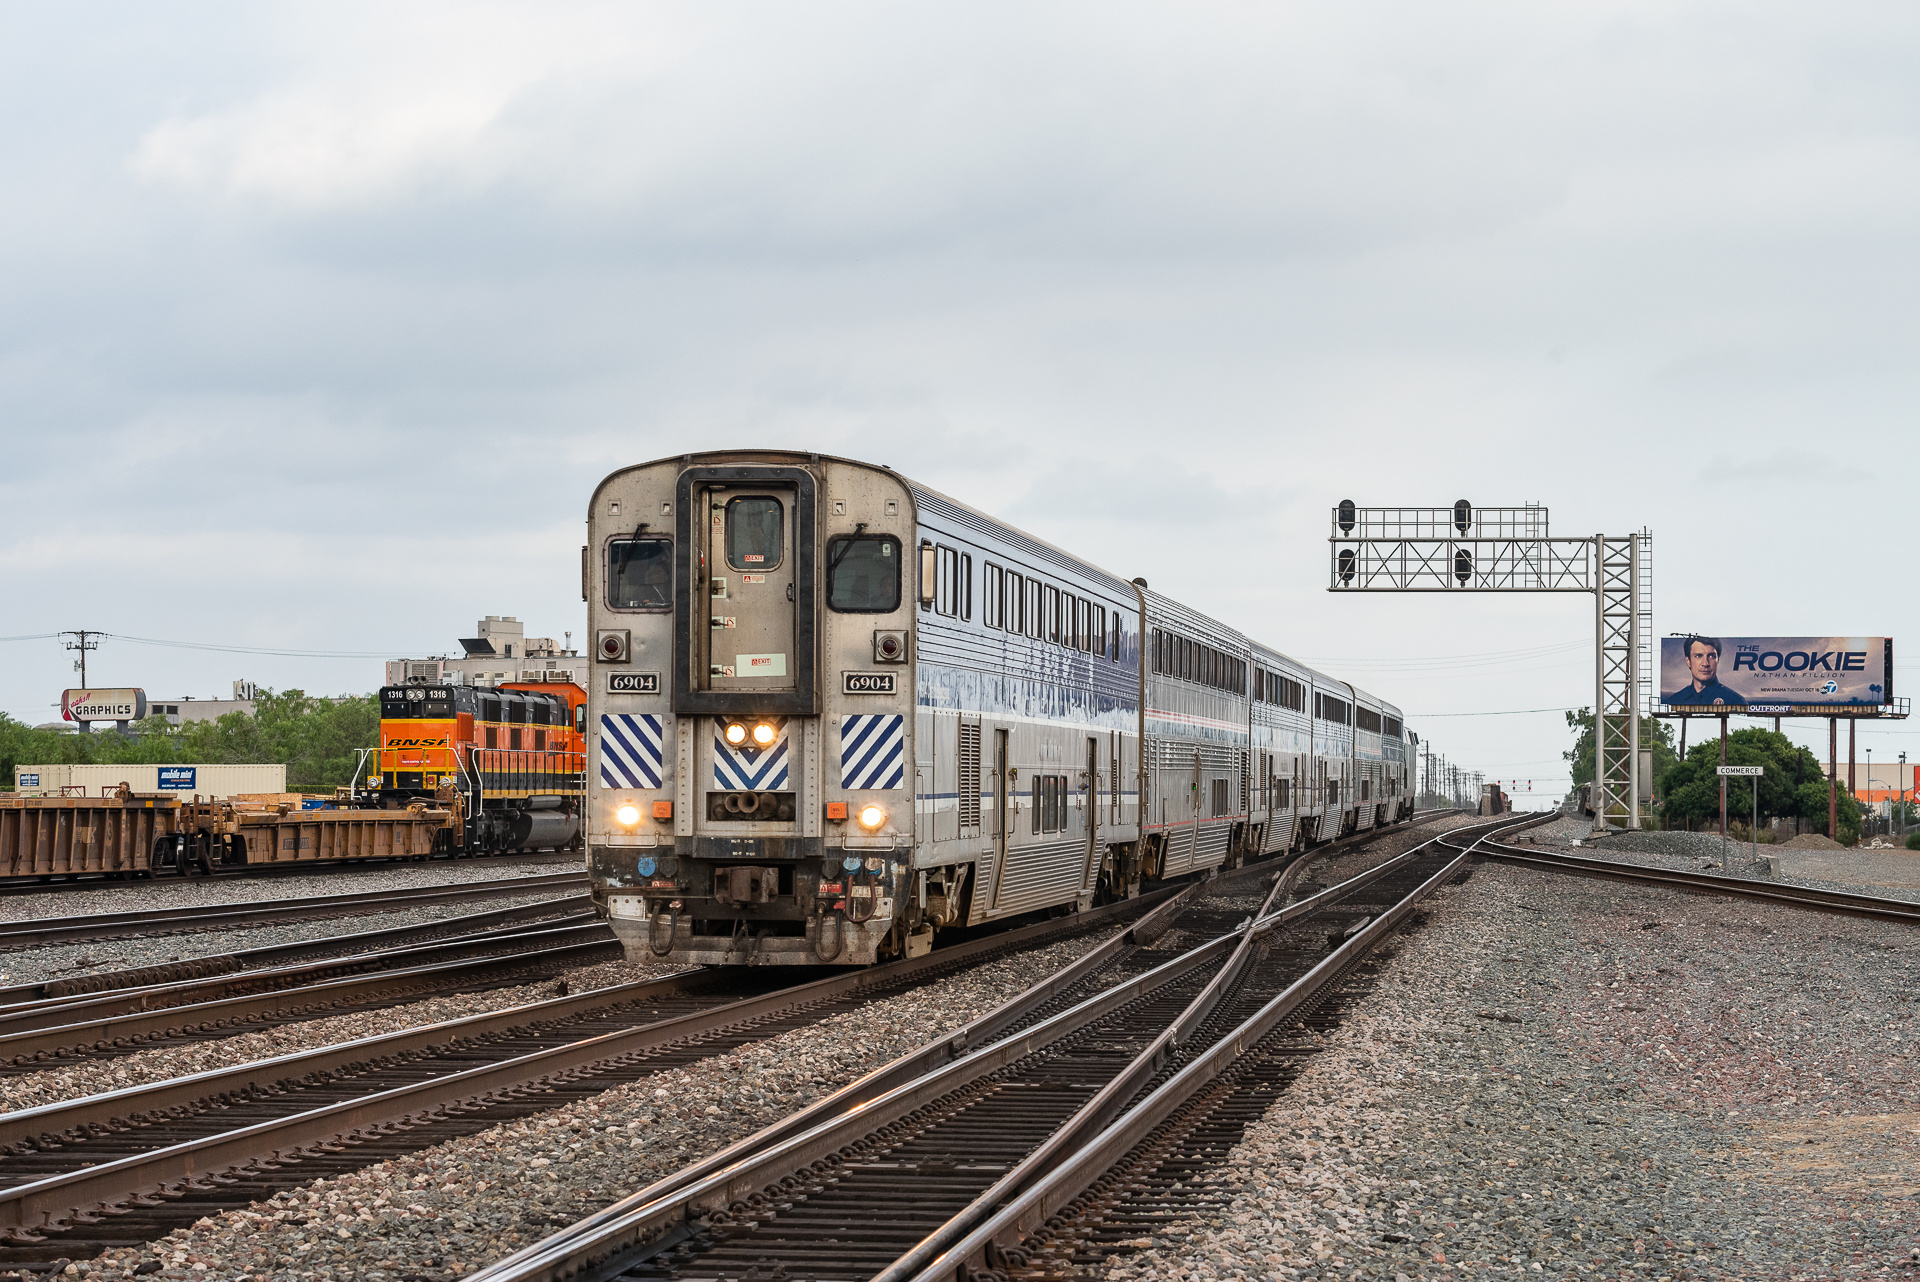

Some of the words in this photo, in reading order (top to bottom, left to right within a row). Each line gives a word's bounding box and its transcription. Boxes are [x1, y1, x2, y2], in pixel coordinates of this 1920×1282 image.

[1732, 651, 1868, 672] ROOKIE
[613, 676, 654, 690] 6904
[850, 676, 891, 690] 6904
[387, 690, 403, 699] 1316
[429, 690, 447, 699] 1316
[75, 705, 131, 715] GRAPHICS
[1749, 704, 1790, 712] OUTFRONT
[387, 738, 452, 746] BNSF
[1720, 767, 1759, 775] COMMERCE
